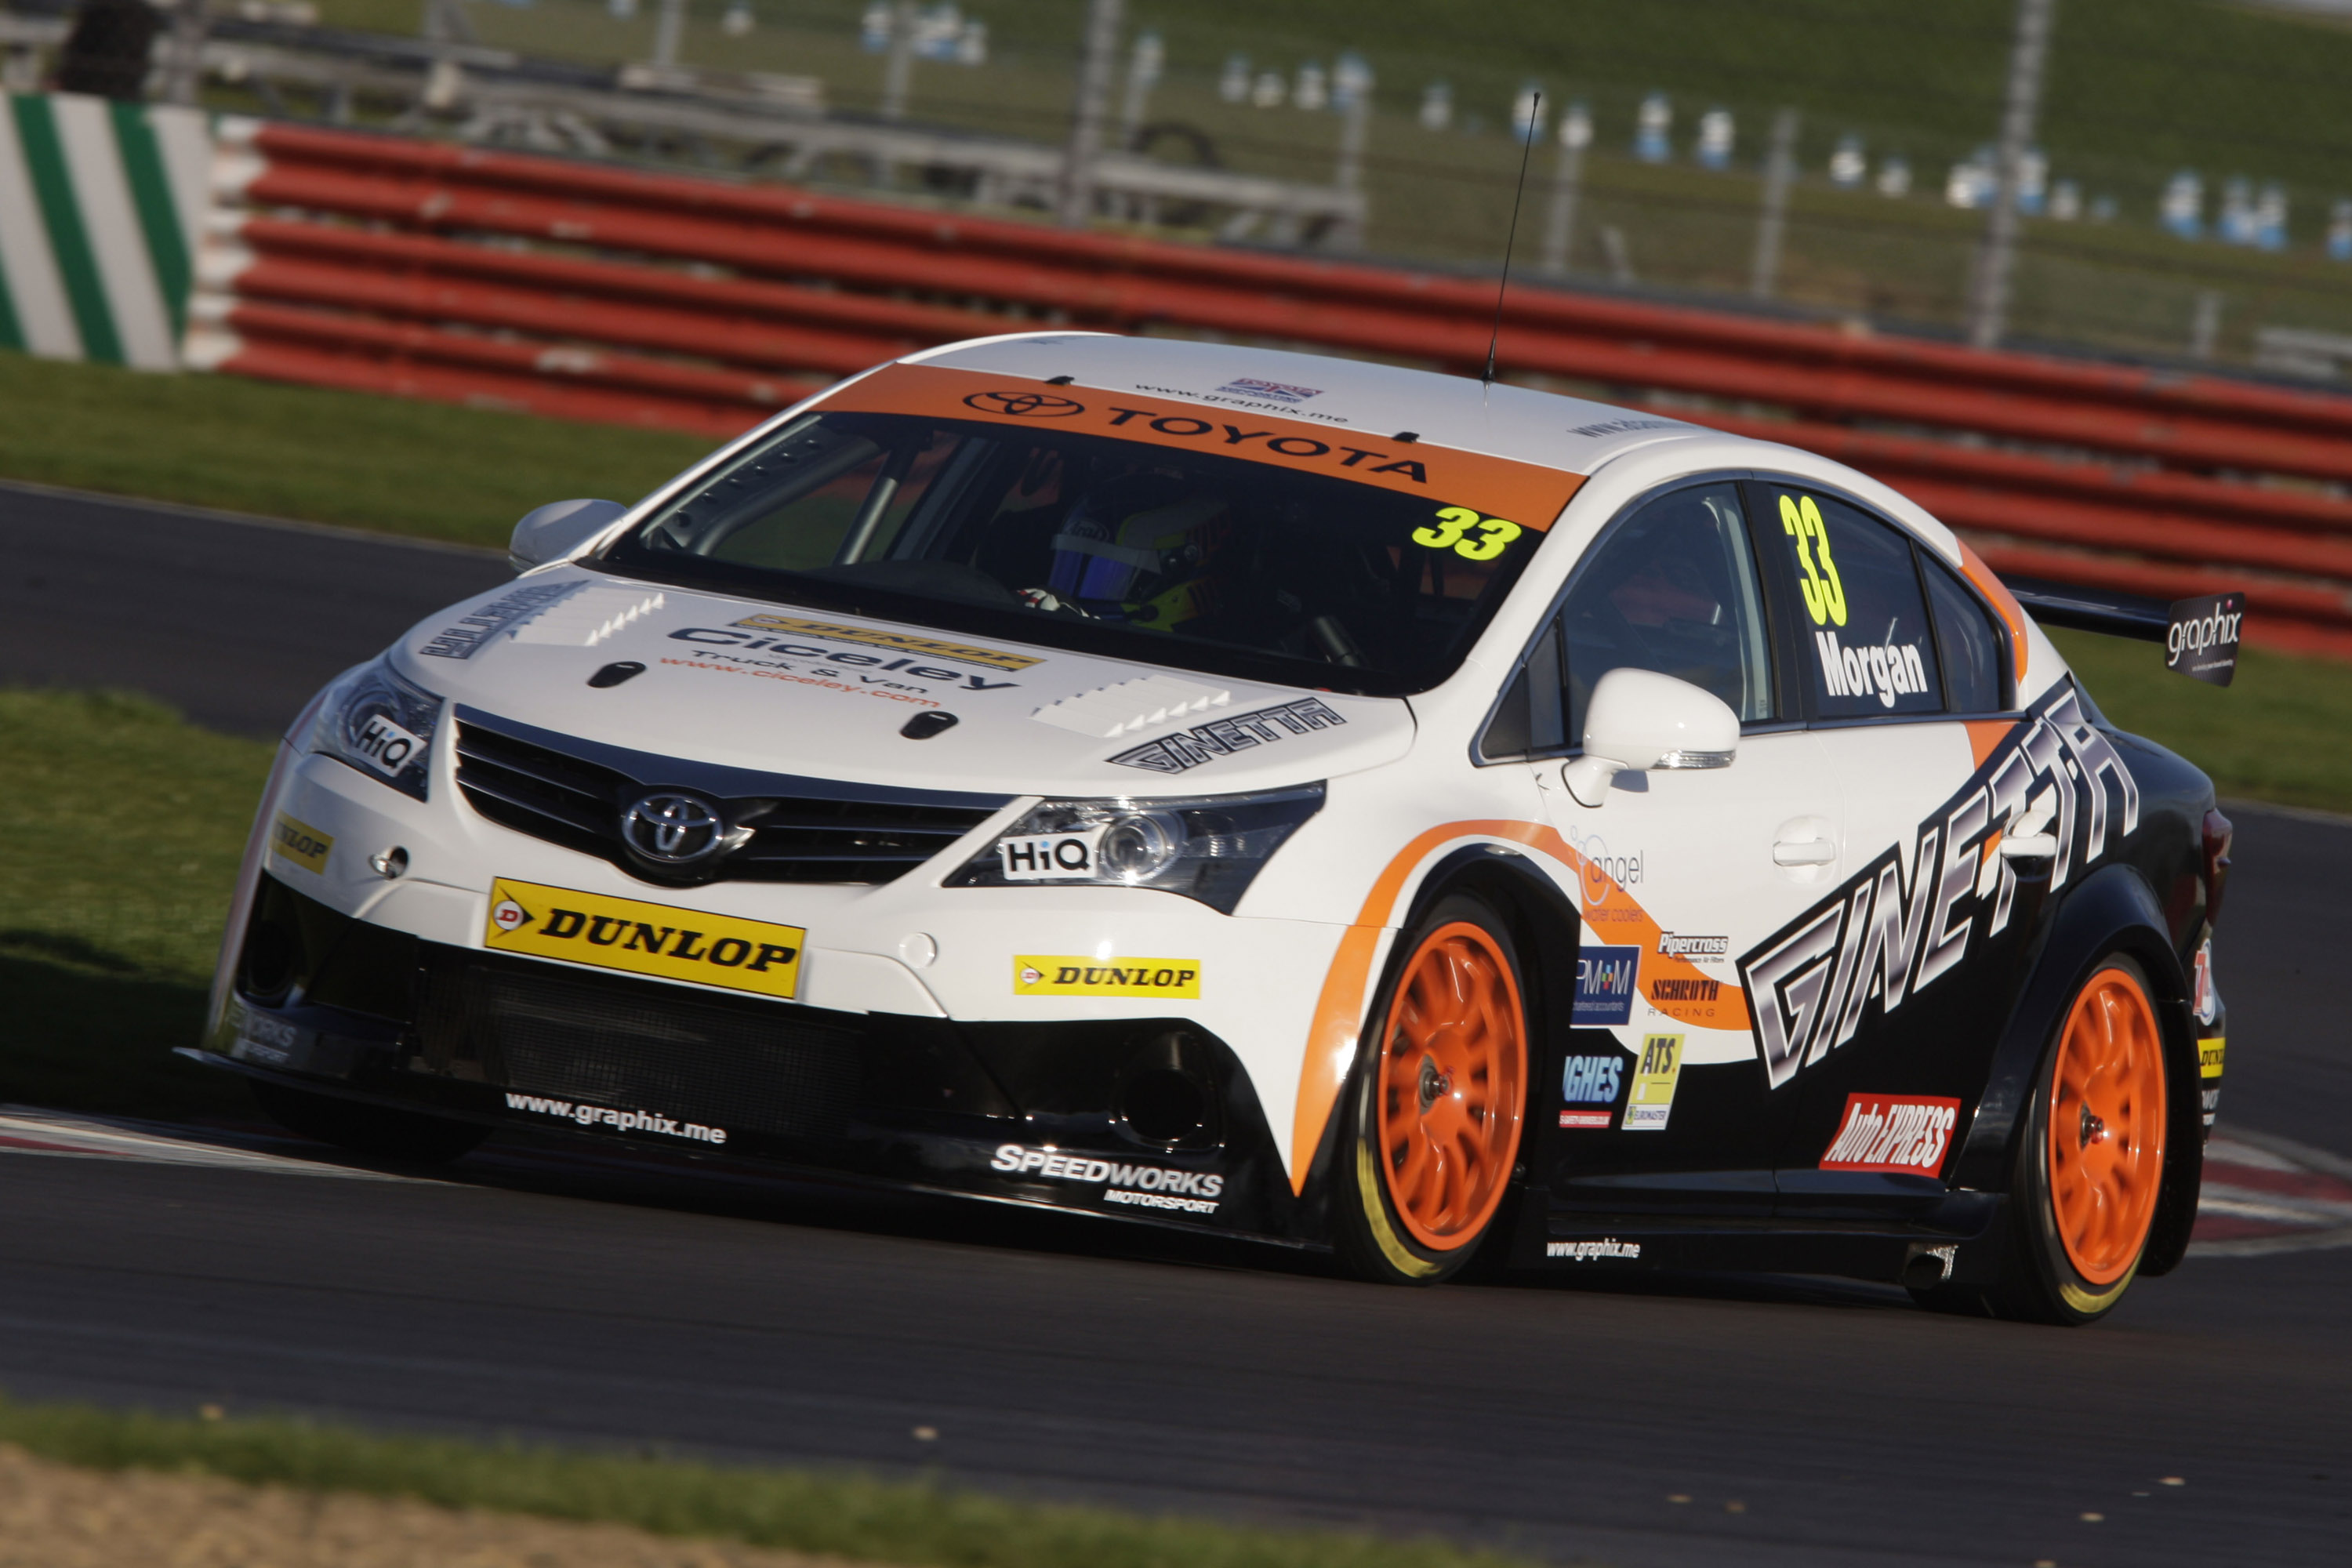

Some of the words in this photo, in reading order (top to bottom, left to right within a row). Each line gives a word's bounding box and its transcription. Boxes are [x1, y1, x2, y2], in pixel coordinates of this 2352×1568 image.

[1136, 384, 1348, 423] www.graphix.me
[1108, 406, 1428, 484] TOYOTA
[1411, 507, 1523, 561] 33
[1779, 495, 1847, 626] 33
[791, 624, 1036, 665] DUNLOP
[2169, 599, 2241, 666] graphix
[659, 657, 941, 707] www.ciceley.com
[667, 627, 1022, 691] Ciceley
[692, 650, 799, 670] Truck
[810, 668, 840, 679] &
[859, 674, 929, 694] Van
[1815, 631, 1928, 708] Morgan
[356, 720, 412, 769] HiQ
[1104, 696, 1348, 775] GINETTA
[1007, 838, 1090, 872] HiQ
[1591, 850, 1643, 892] angel
[1740, 687, 2139, 1091] GINETTA
[539, 908, 797, 972] DUNLOP
[1657, 931, 1729, 959] Pipercross
[1053, 966, 1196, 988] DUNLOP
[1651, 979, 1720, 1001] SCHROTH
[1648, 1007, 1715, 1018] RACING
[506, 1092, 727, 1144] www.graphix.me
[990, 1145, 1224, 1196] SPEEDWORKS
[1104, 1189, 1219, 1214] MOTORSPORT
[1547, 1238, 1640, 1261] www.graphix.me
